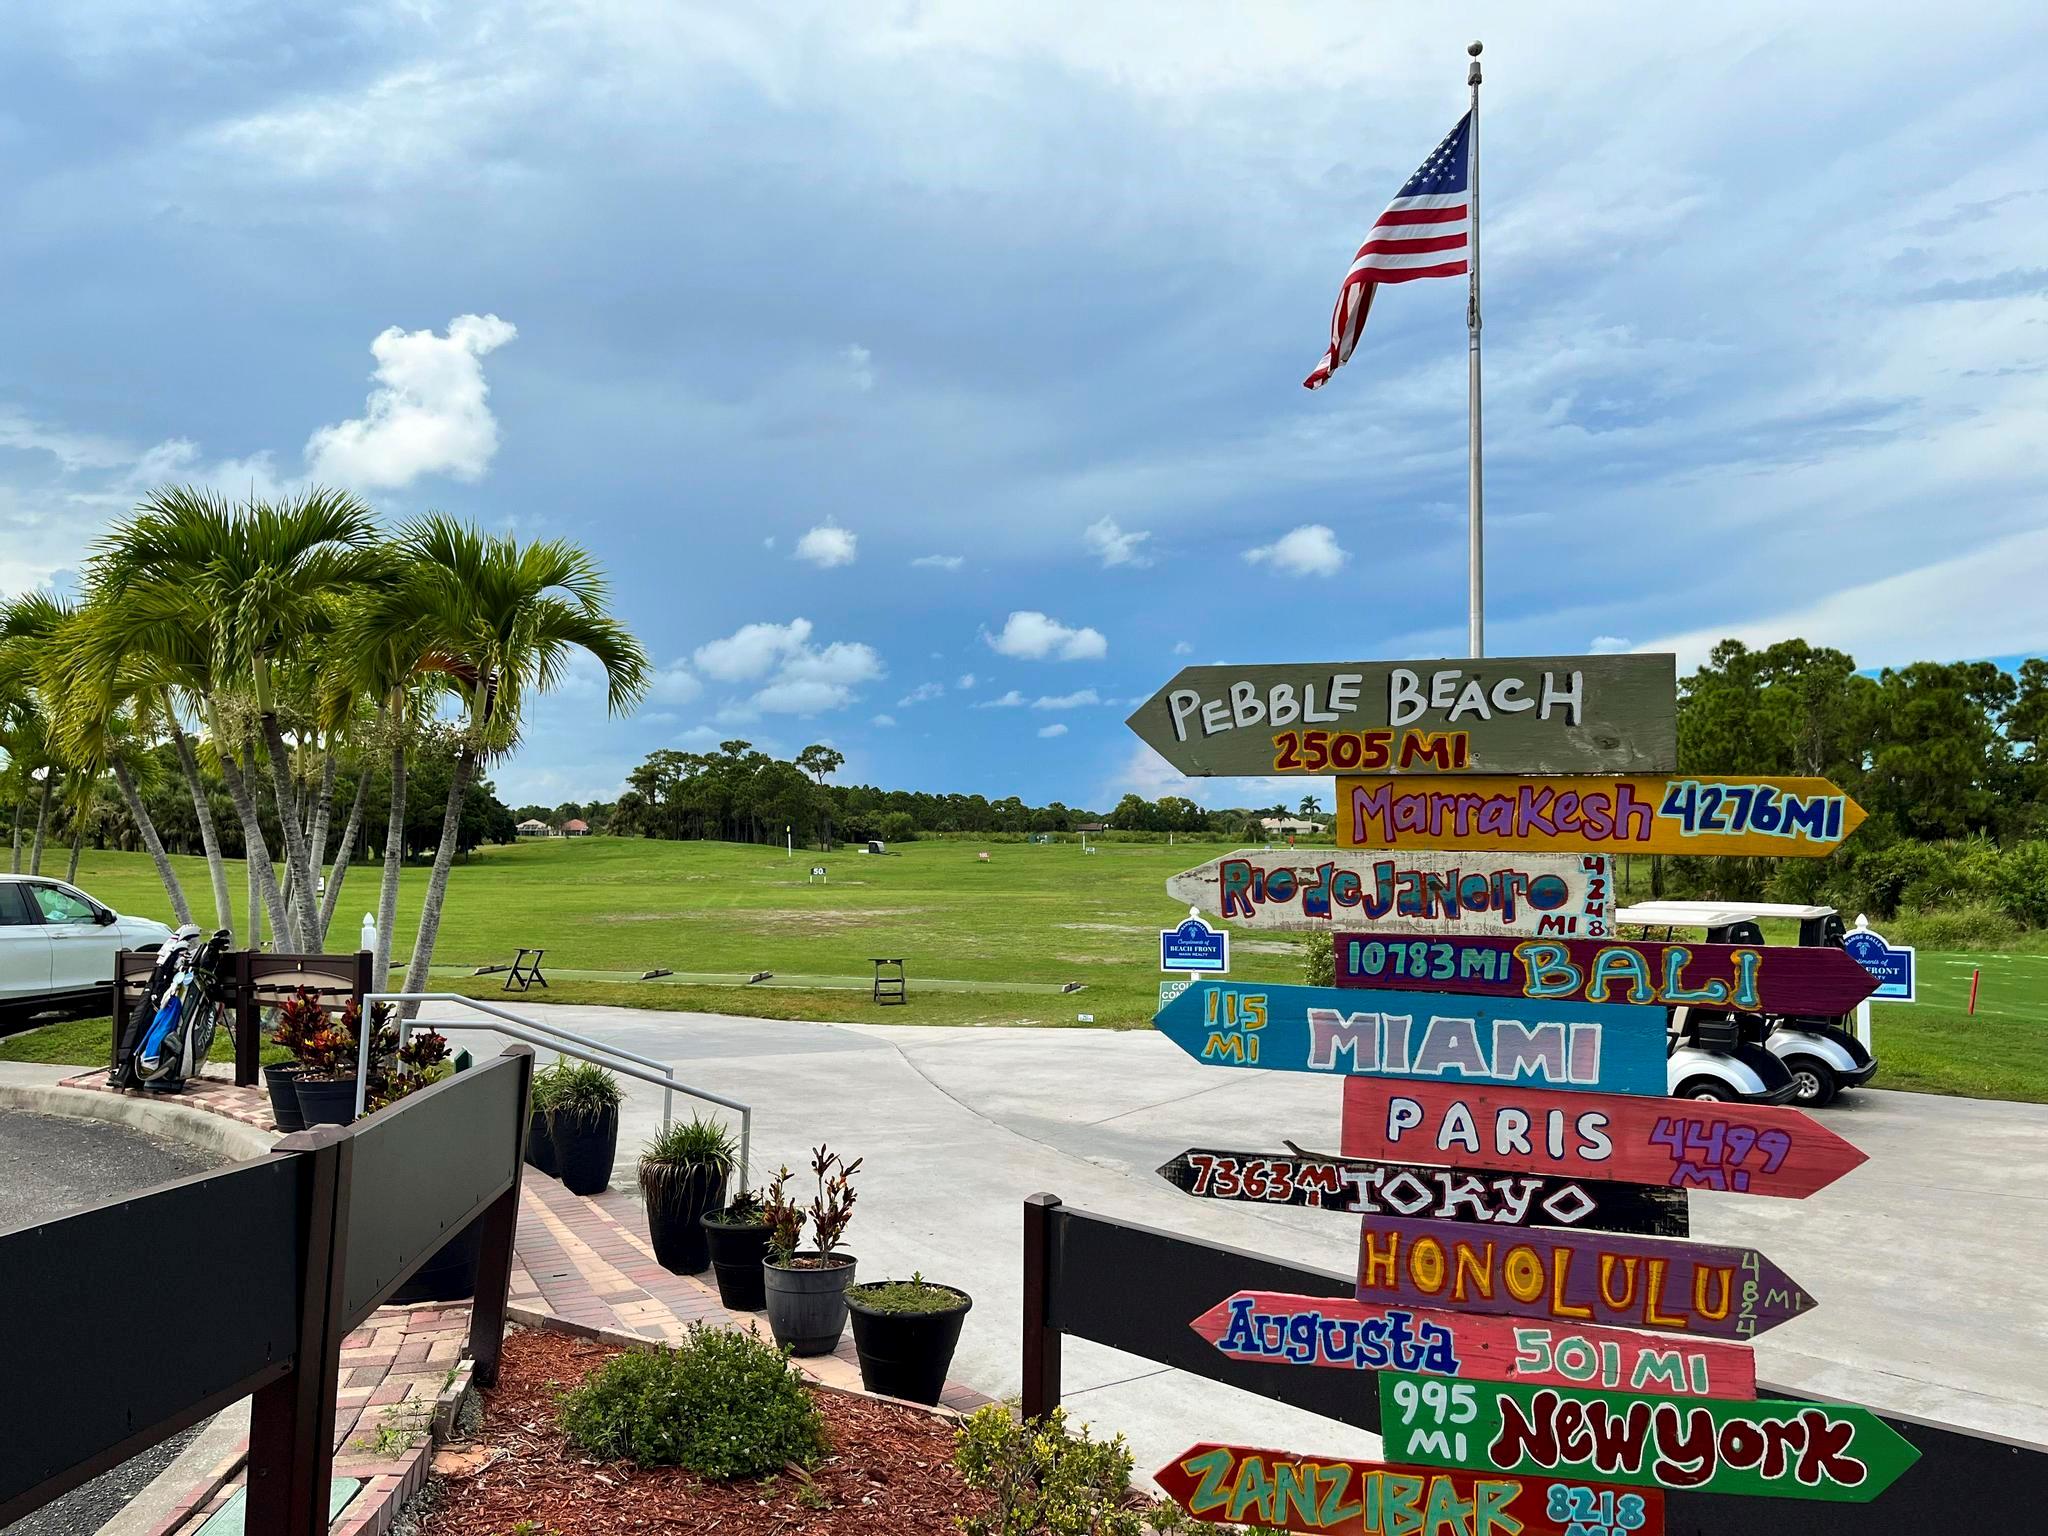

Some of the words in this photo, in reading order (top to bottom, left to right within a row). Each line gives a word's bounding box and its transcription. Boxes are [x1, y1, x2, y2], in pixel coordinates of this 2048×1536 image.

[1167, 673, 1363, 742] PEBBLE
[1386, 668, 1583, 727] BEACH
[1272, 728, 1394, 771] 2505
[1398, 728, 1470, 770] MI
[1536, 912, 1579, 936] MI
[1346, 939, 1456, 979] 10783
[1458, 944, 1511, 981] MI
[1513, 940, 1764, 1010] BALI
[1866, 967, 1899, 975] FRONT
[1203, 986, 1269, 1030] 115
[1202, 1031, 1261, 1065] MI
[1306, 1006, 1603, 1086] MIAMI
[1386, 1096, 1614, 1161] PARIS
[1648, 1117, 1793, 1175] 4499
[1187, 1153, 1294, 1201] 7363
[1338, 1166, 1597, 1224] TOKYO
[1668, 1160, 1751, 1193] MI
[1363, 1229, 1736, 1329] HONOLULU
[1763, 1287, 1802, 1311] MI
[1217, 1297, 1462, 1376] Augusta
[1512, 1326, 1622, 1389] 501
[1629, 1347, 1711, 1396] MI
[1393, 1380, 1479, 1426] 995
[1405, 1427, 1468, 1463] MI
[1179, 1446, 1526, 1536] ZANZIBAR
[1546, 1483, 1647, 1531] 8218
